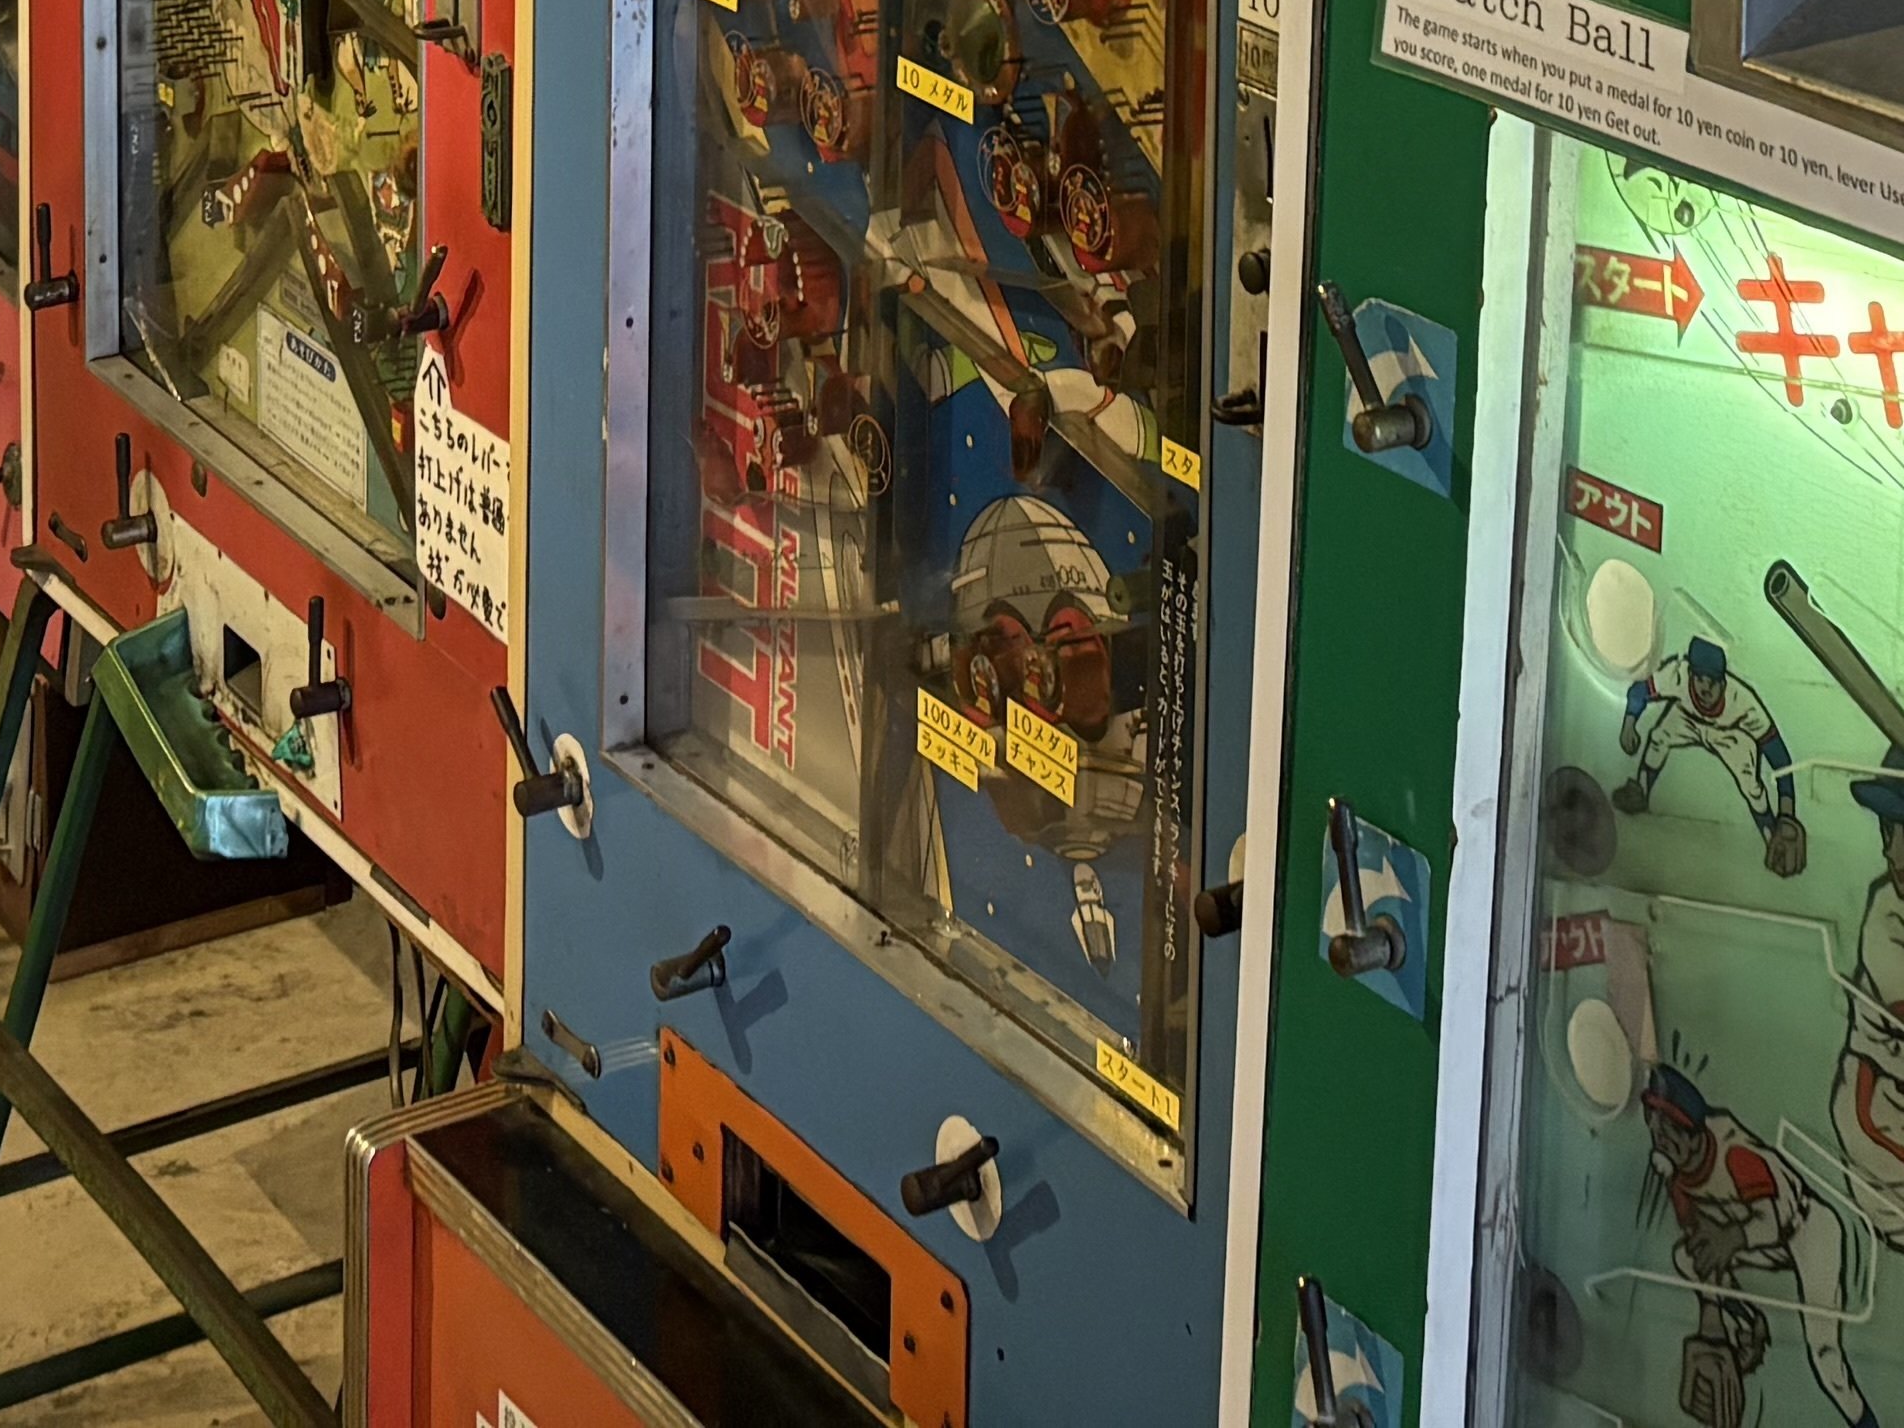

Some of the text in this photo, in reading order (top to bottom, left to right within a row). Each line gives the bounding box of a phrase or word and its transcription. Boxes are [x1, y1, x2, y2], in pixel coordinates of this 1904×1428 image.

[1565, 3, 1655, 72] Ball
[1394, 37, 1661, 146] you score, one medal for 10 yen Get out.
[1398, 6, 1420, 29] The
[1423, 17, 1459, 42] game
[1462, 26, 1498, 56] starts
[1501, 41, 1538, 69] when
[1541, 58, 1566, 81] you
[1569, 66, 1593, 90] put
[1595, 78, 1604, 93] a
[1607, 80, 1650, 111] medal
[1653, 96, 1674, 119] for
[1677, 105, 1694, 127] 10
[1697, 117, 1722, 141] yen
[1726, 129, 1756, 151] coin
[1759, 141, 1775, 158] or
[1779, 146, 1798, 167] 10
[1837, 166, 1876, 195] lever
[1575, 254, 1689, 317] スタート
[417, 493, 482, 565] ありません
[1575, 480, 1652, 538] アウト
[921, 730, 976, 779] ラッキー
[922, 696, 993, 759] 100メダル
[1012, 709, 1076, 765] 10メダル
[1009, 741, 1068, 796] チャンス
